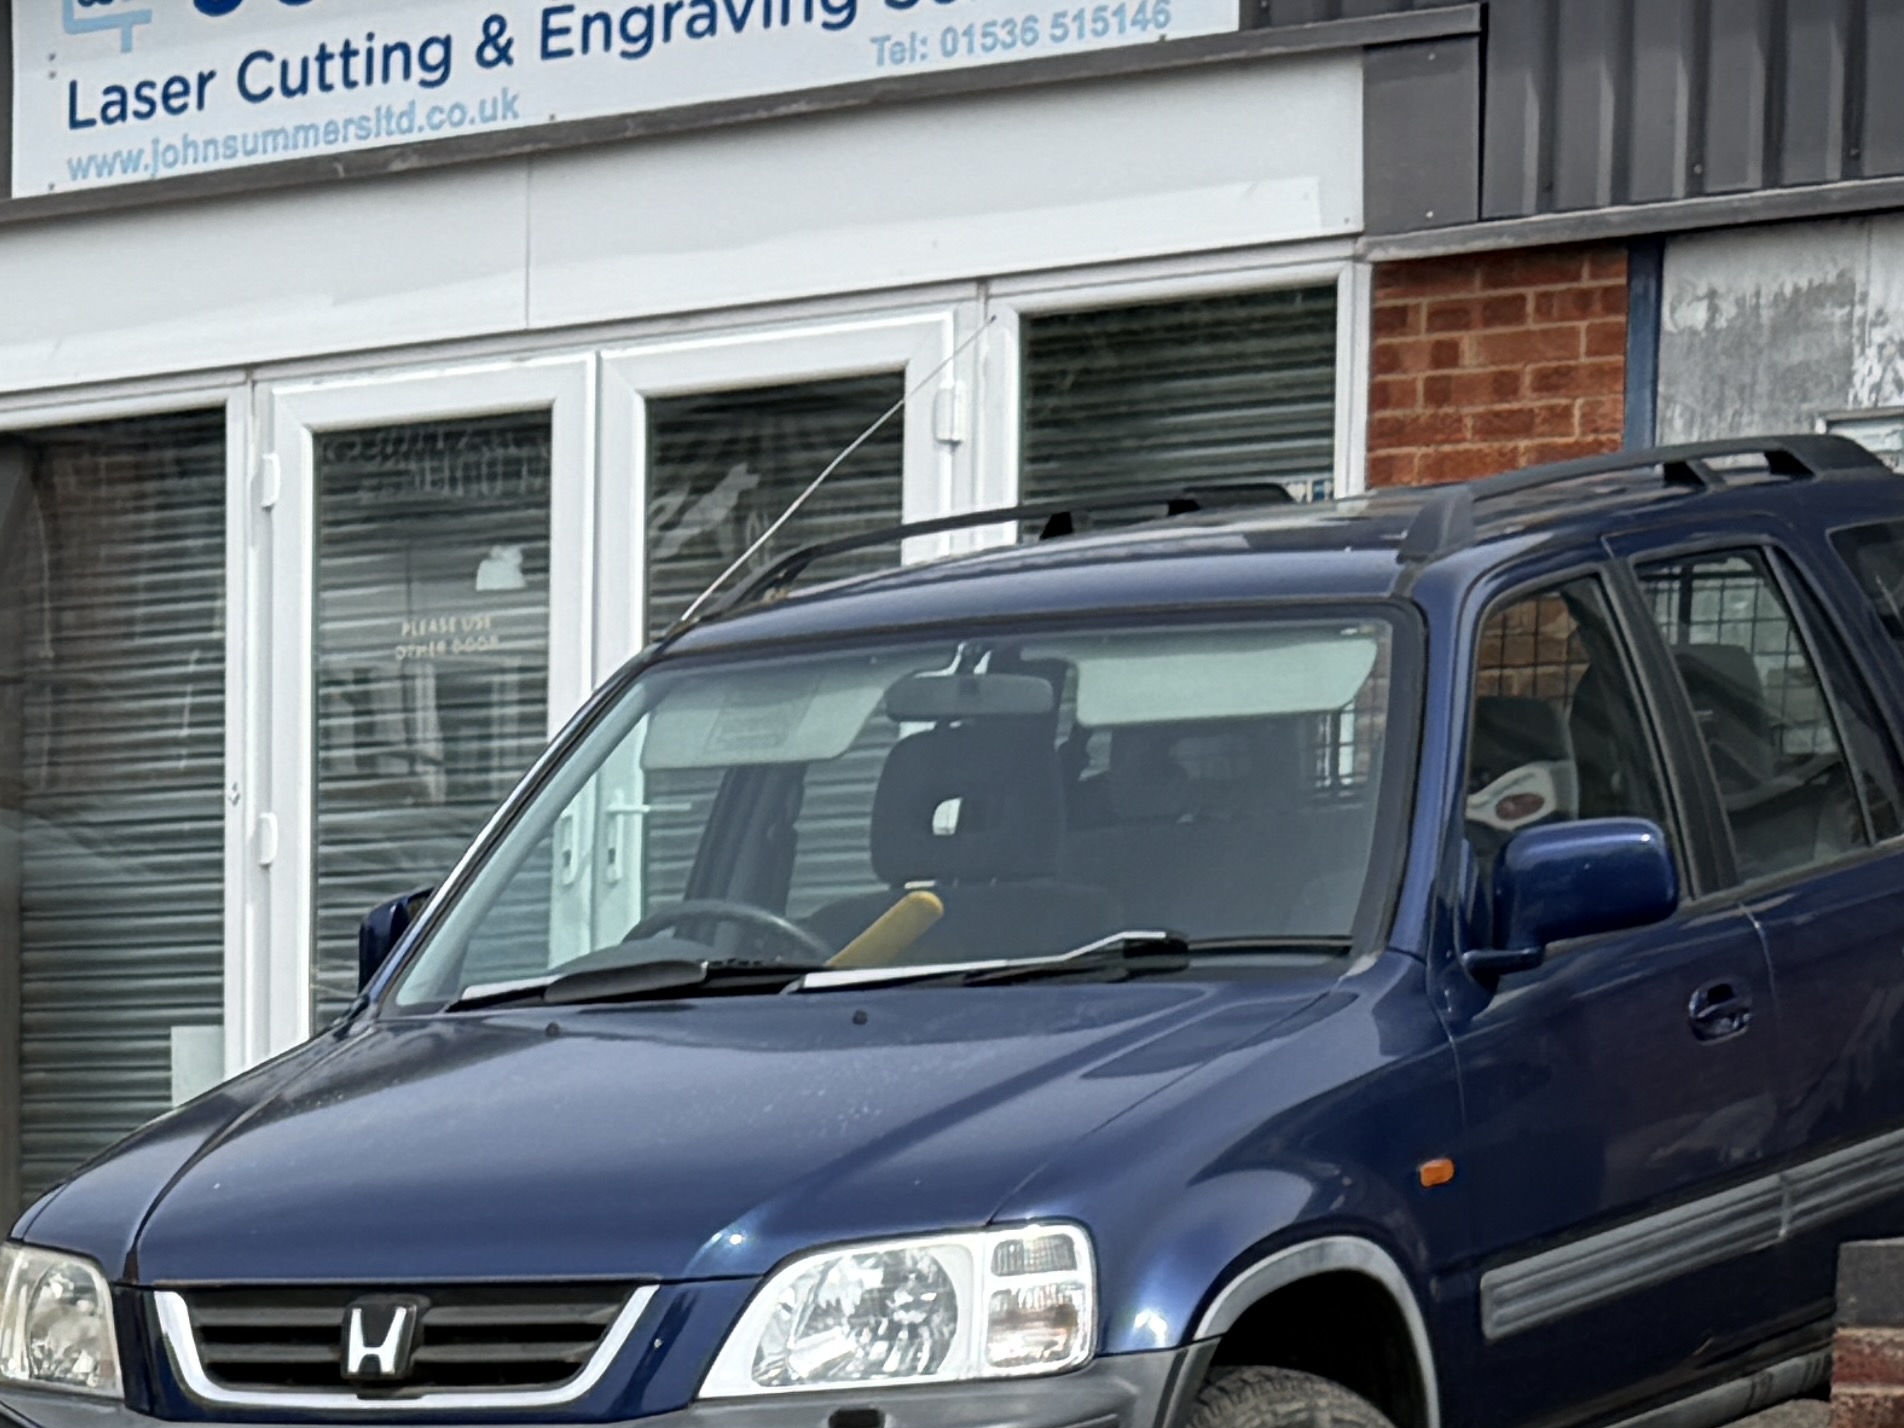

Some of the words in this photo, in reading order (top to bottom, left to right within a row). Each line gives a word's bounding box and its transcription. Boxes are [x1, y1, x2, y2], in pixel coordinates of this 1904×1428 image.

[66, 66, 218, 131] Laser
[236, 32, 453, 103] Cutting
[474, 13, 515, 69] &
[869, 31, 928, 67] Tel:
[940, 13, 1039, 58] 01536
[1048, 0, 1172, 46] 515146
[66, 86, 522, 182] www.johnsummersltd.co.uk
